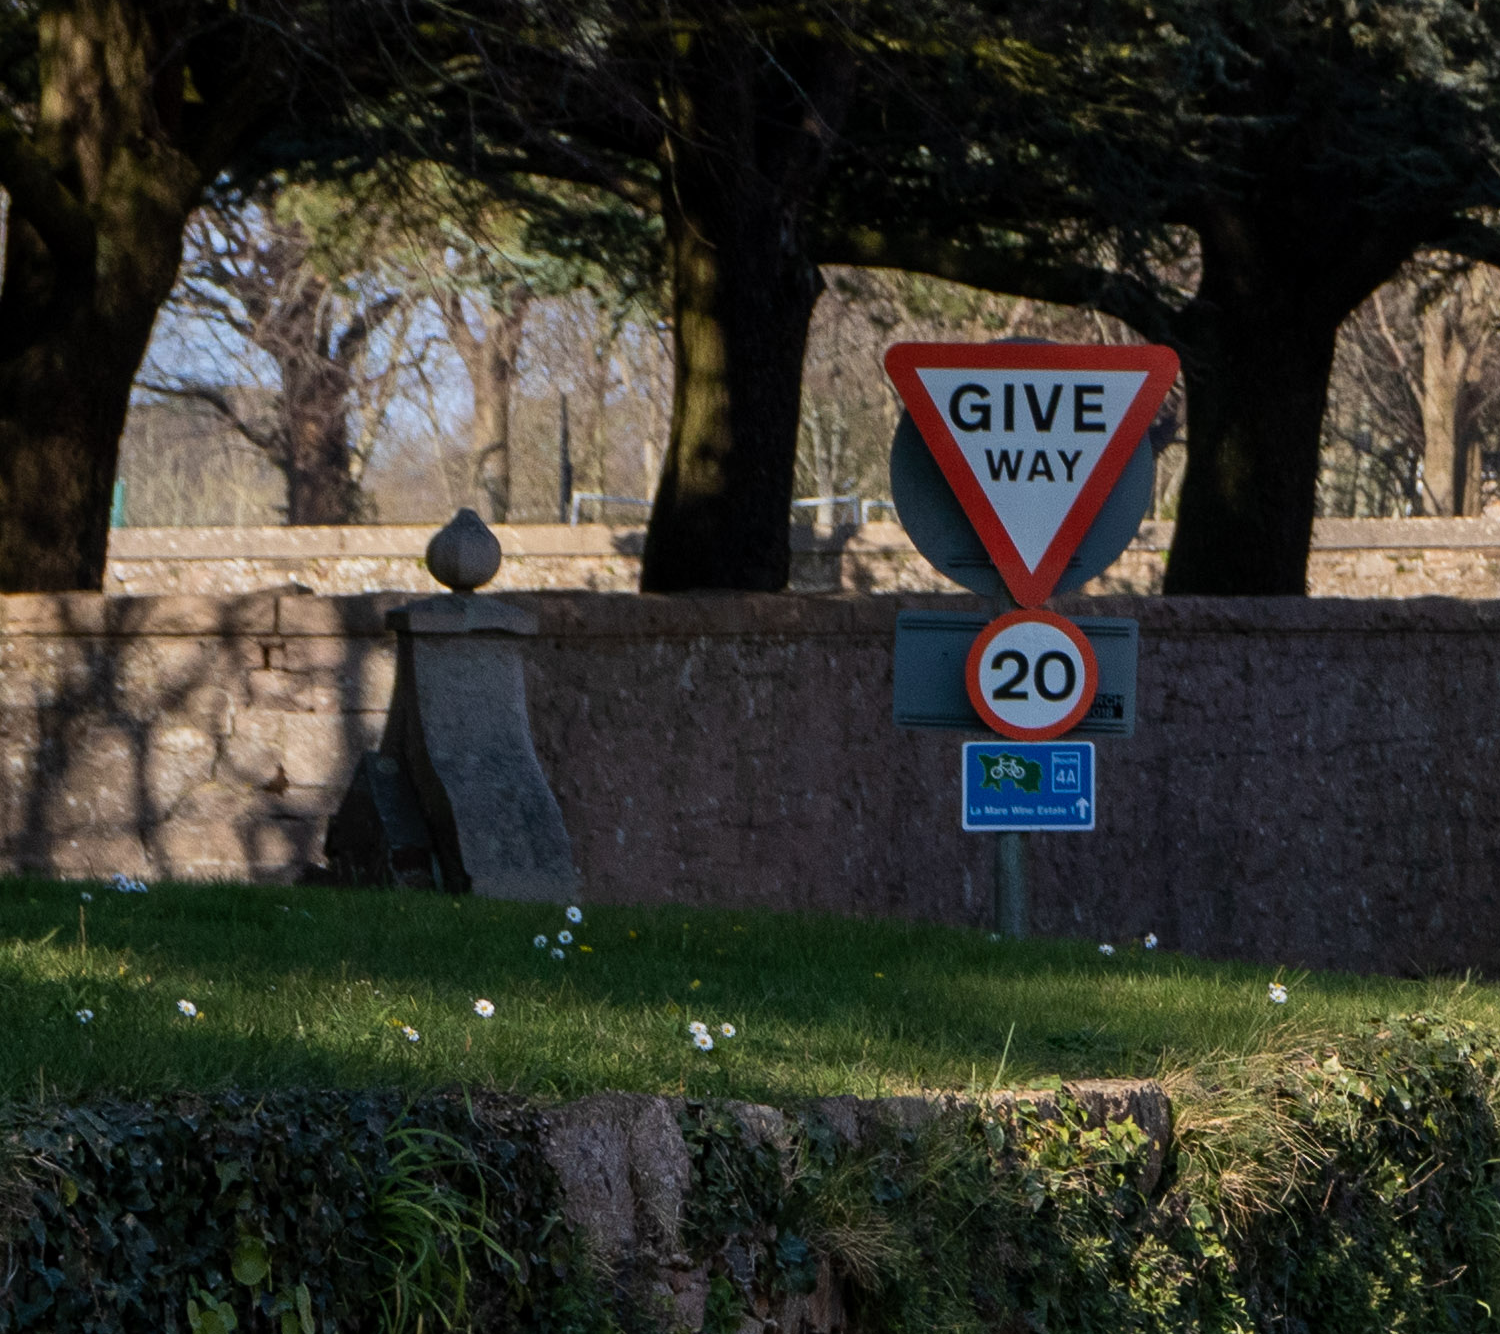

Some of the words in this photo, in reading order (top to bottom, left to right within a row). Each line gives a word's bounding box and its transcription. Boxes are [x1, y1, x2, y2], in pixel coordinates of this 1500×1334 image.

[948, 383, 1107, 433] GIVE
[984, 449, 1083, 482] WAY
[990, 649, 1076, 701] 20
[1055, 769, 1076, 785] 4A
[969, 805, 982, 816] La
[984, 805, 1009, 816] Mare
[1011, 805, 1034, 816] Wine
[1037, 805, 1068, 816] Estate
